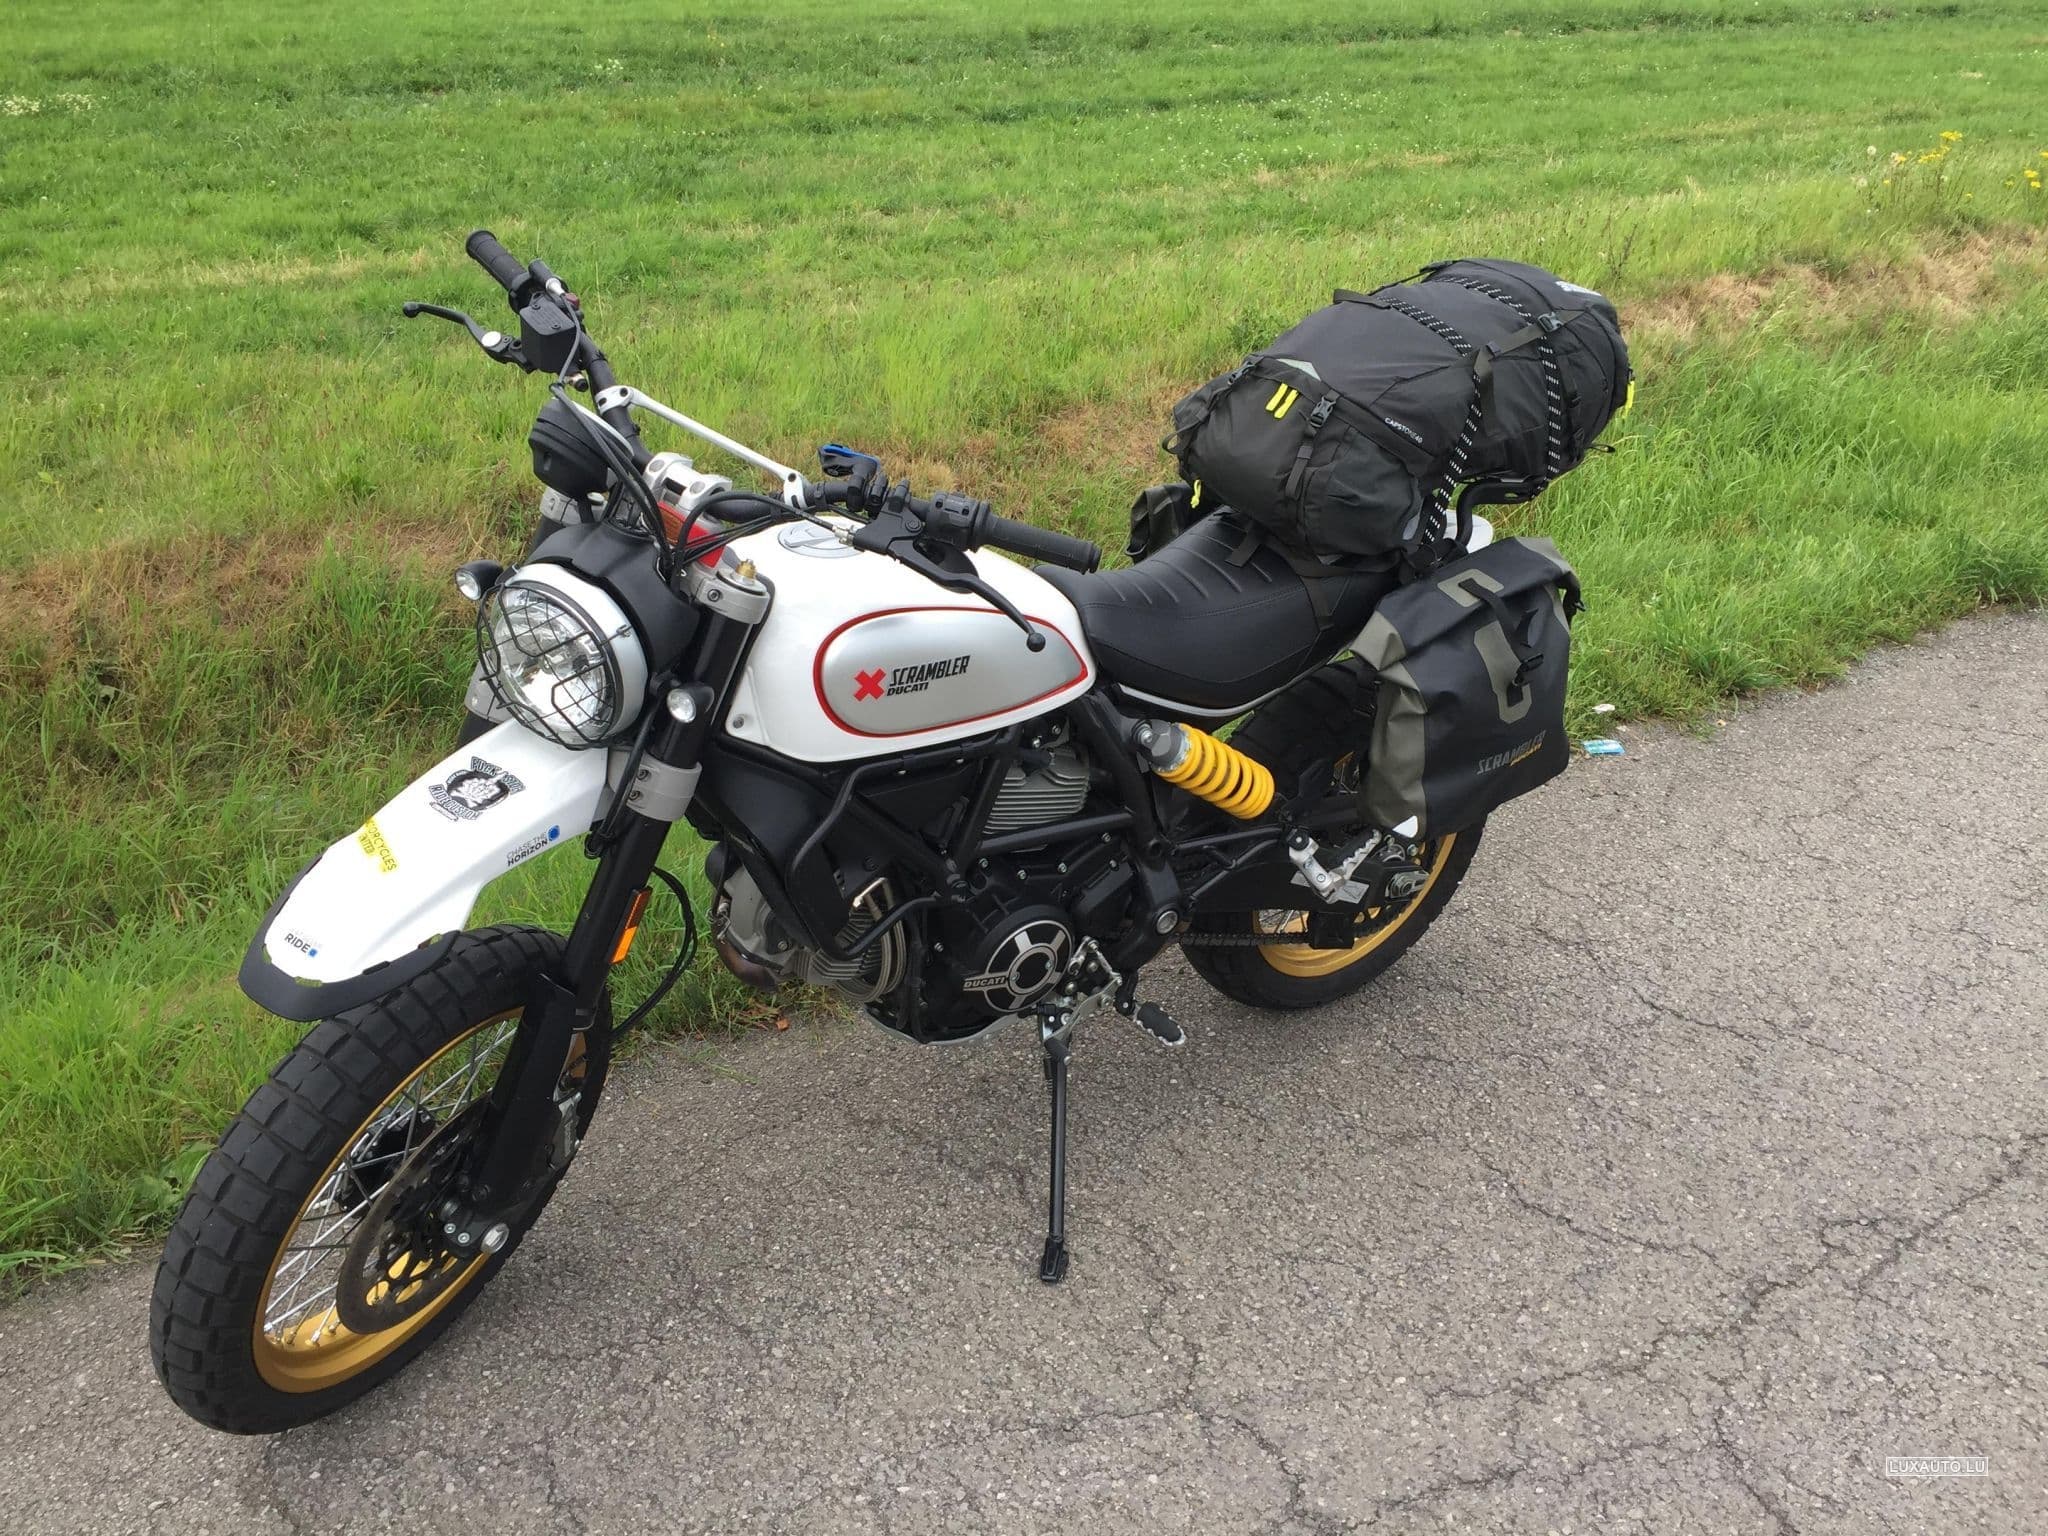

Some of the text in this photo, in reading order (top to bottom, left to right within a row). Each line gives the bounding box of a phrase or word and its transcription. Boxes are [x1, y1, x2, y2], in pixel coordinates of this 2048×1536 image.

[889, 655, 971, 687] SCRAMBLER
[886, 682, 929, 696] DUCATI
[507, 838, 548, 866] HORIZON
[284, 933, 311, 954] RIDE
[963, 976, 1006, 988] DUCATI
